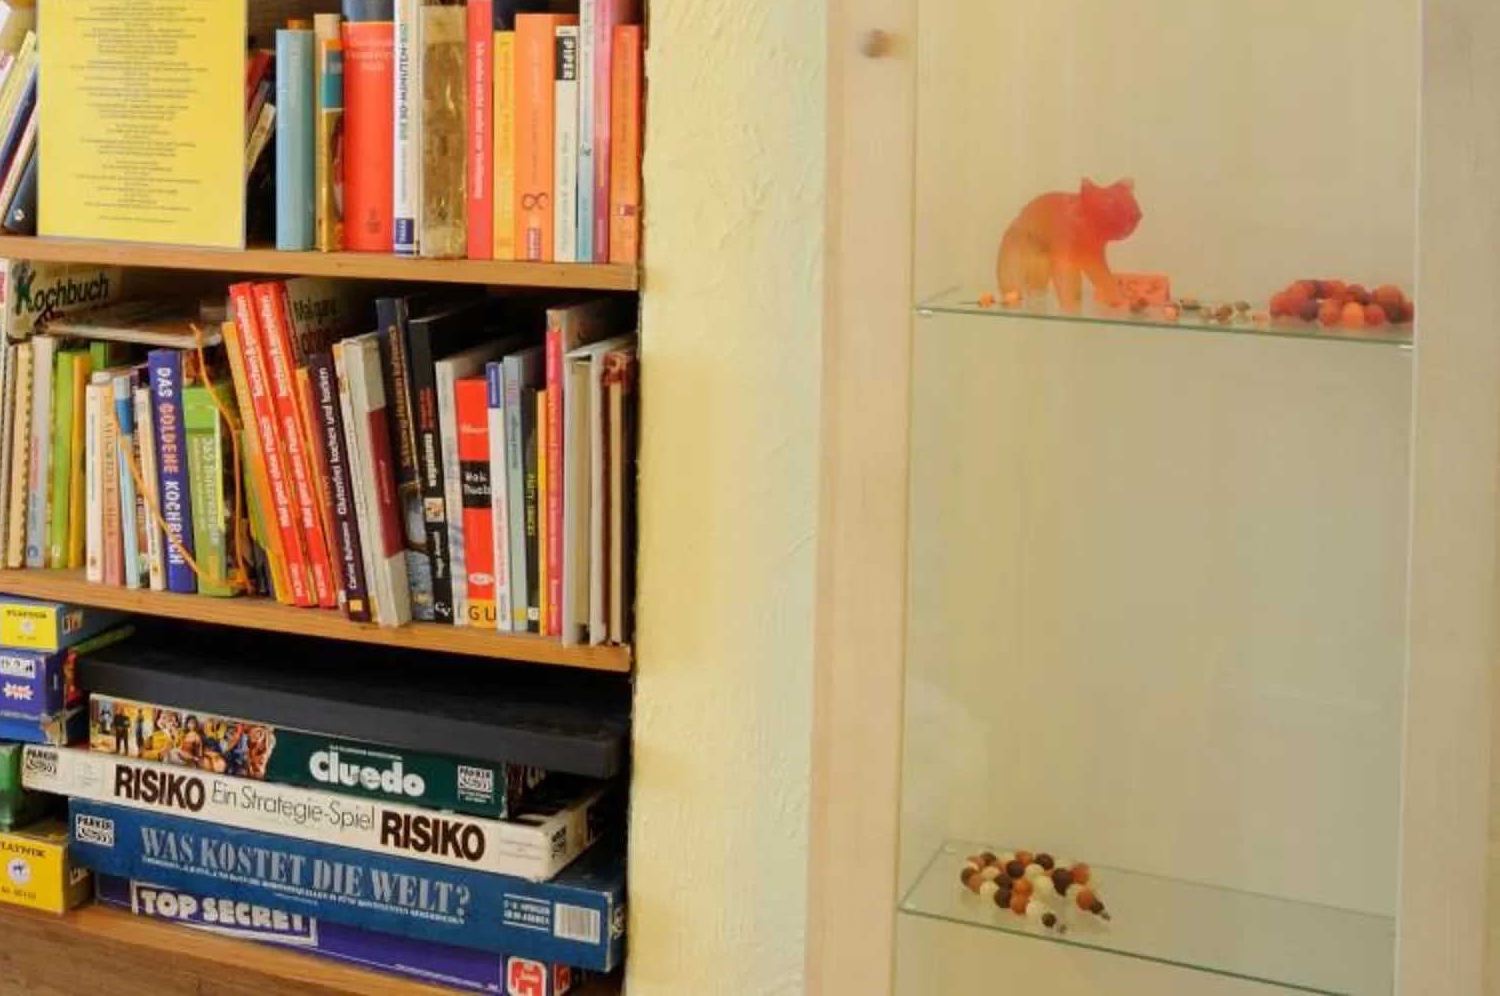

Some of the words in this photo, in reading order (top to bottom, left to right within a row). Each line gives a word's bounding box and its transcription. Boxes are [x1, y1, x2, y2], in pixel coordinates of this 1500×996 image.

[563, 39, 575, 79] PIPER
[14, 269, 111, 315] Kochbuch
[156, 366, 174, 399] DAS
[322, 404, 335, 424] und
[157, 402, 181, 476] GOLDENE
[164, 480, 186, 567] KOCHBUCH
[309, 749, 426, 798] cluedo
[113, 763, 206, 813] RISIKO
[211, 779, 237, 805] Ein
[241, 785, 375, 832] Strategie-Spiel
[379, 809, 487, 863] RISIKO
[140, 826, 194, 863] WAS
[200, 839, 307, 885] KOSTET
[313, 860, 368, 897] DIE
[371, 870, 471, 917] WELT?
[139, 889, 198, 920] TOP
